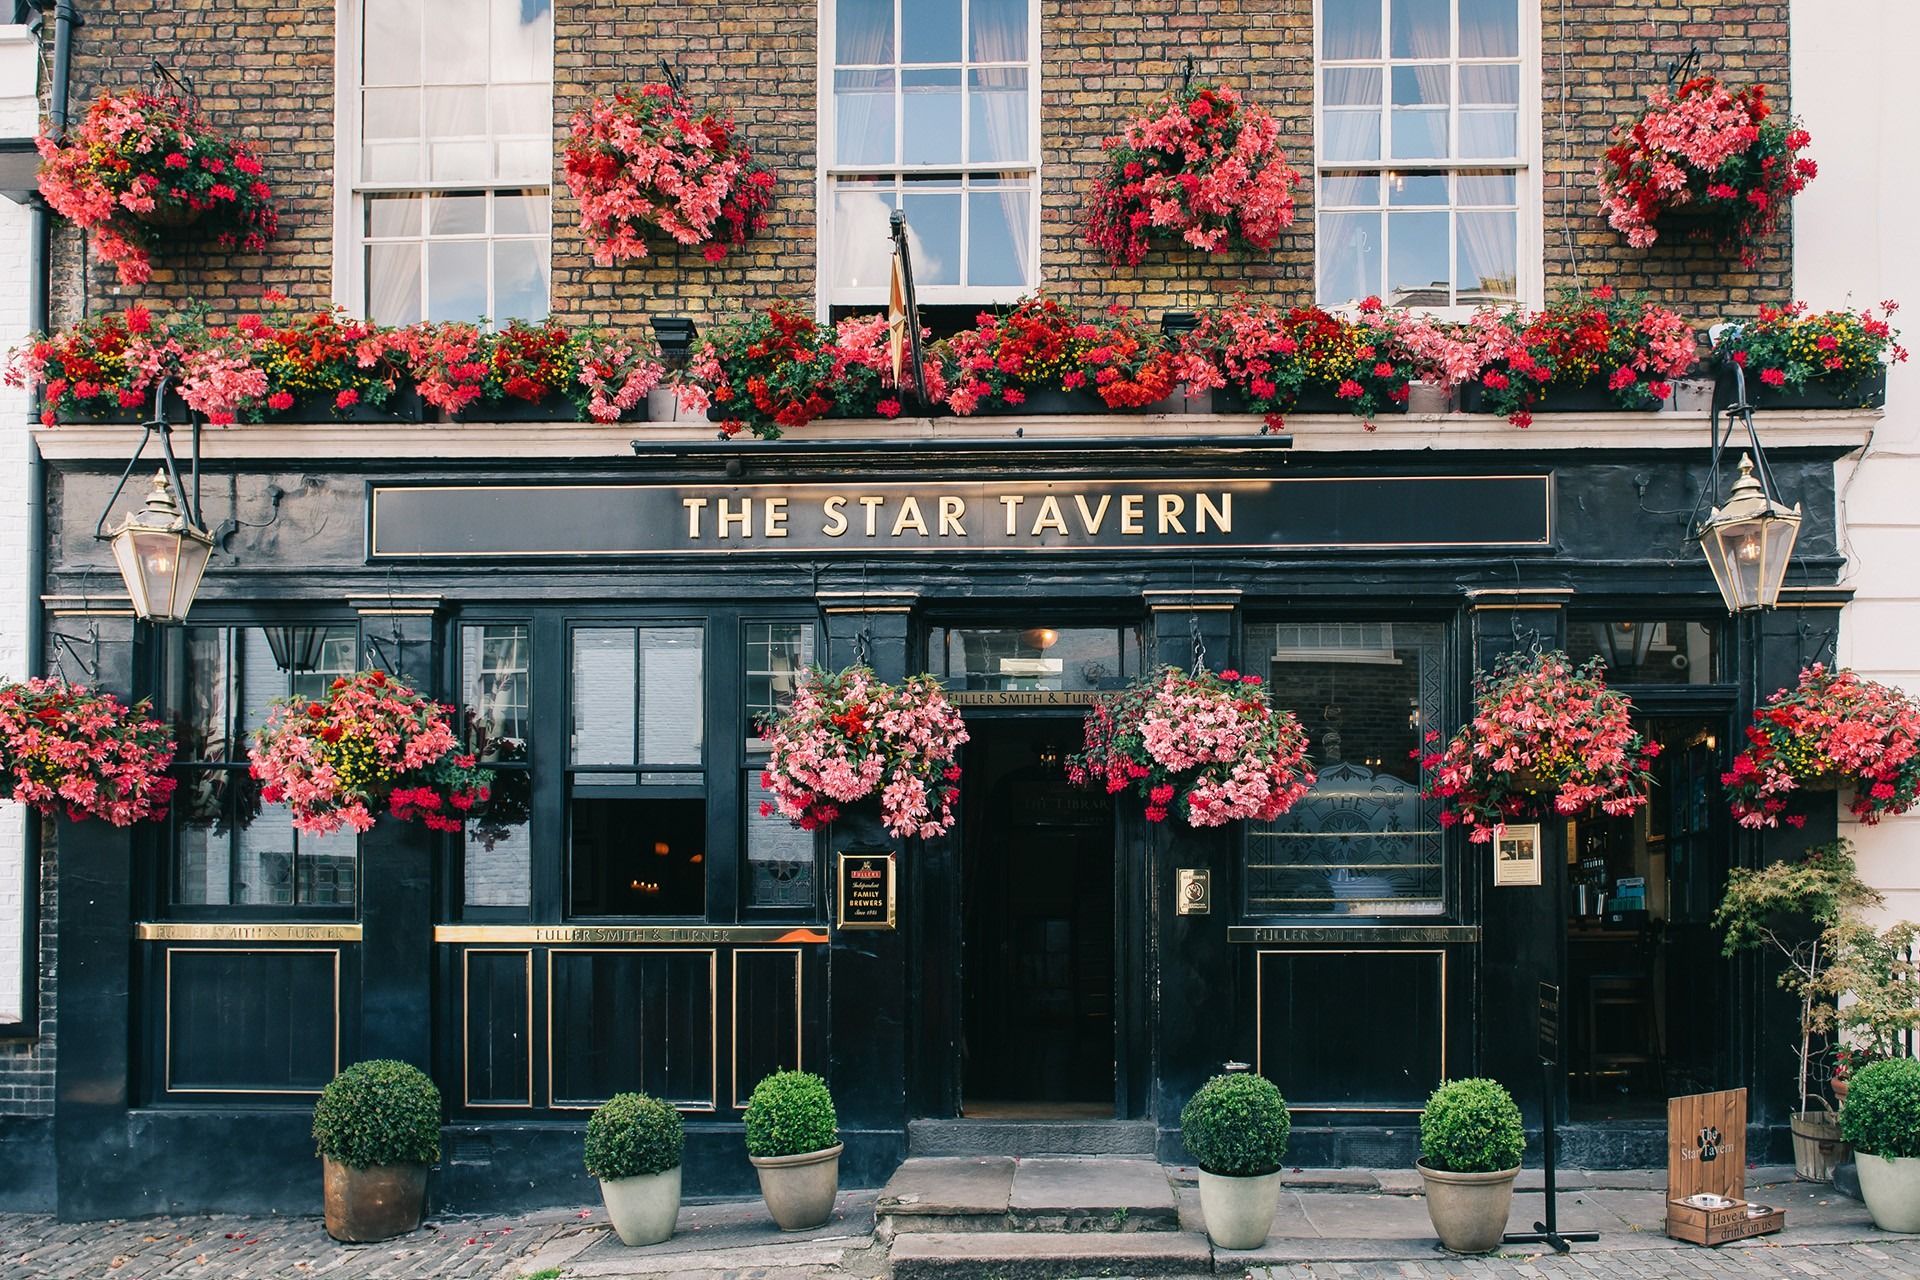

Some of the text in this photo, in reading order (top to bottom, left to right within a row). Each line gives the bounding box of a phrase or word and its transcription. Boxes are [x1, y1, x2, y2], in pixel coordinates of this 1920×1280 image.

[683, 492, 1232, 538] THE STAR TAVERN
[947, 692, 994, 704] FULLER
[999, 692, 1042, 704] SMITH
[1048, 692, 1058, 703] &
[213, 926, 262, 938] SMITH
[268, 927, 280, 937] &
[536, 928, 730, 942] FULLER SMITH & TURNER
[1254, 928, 1309, 941] FULLER
[1314, 928, 1362, 940] SMITH
[1389, 928, 1449, 940] TURNER
[1700, 1128, 1718, 1142] The
[1681, 1143, 1735, 1161] Star Tavern
[1712, 1212, 1746, 1226] Have a
[1720, 1220, 1773, 1240] drink on us
